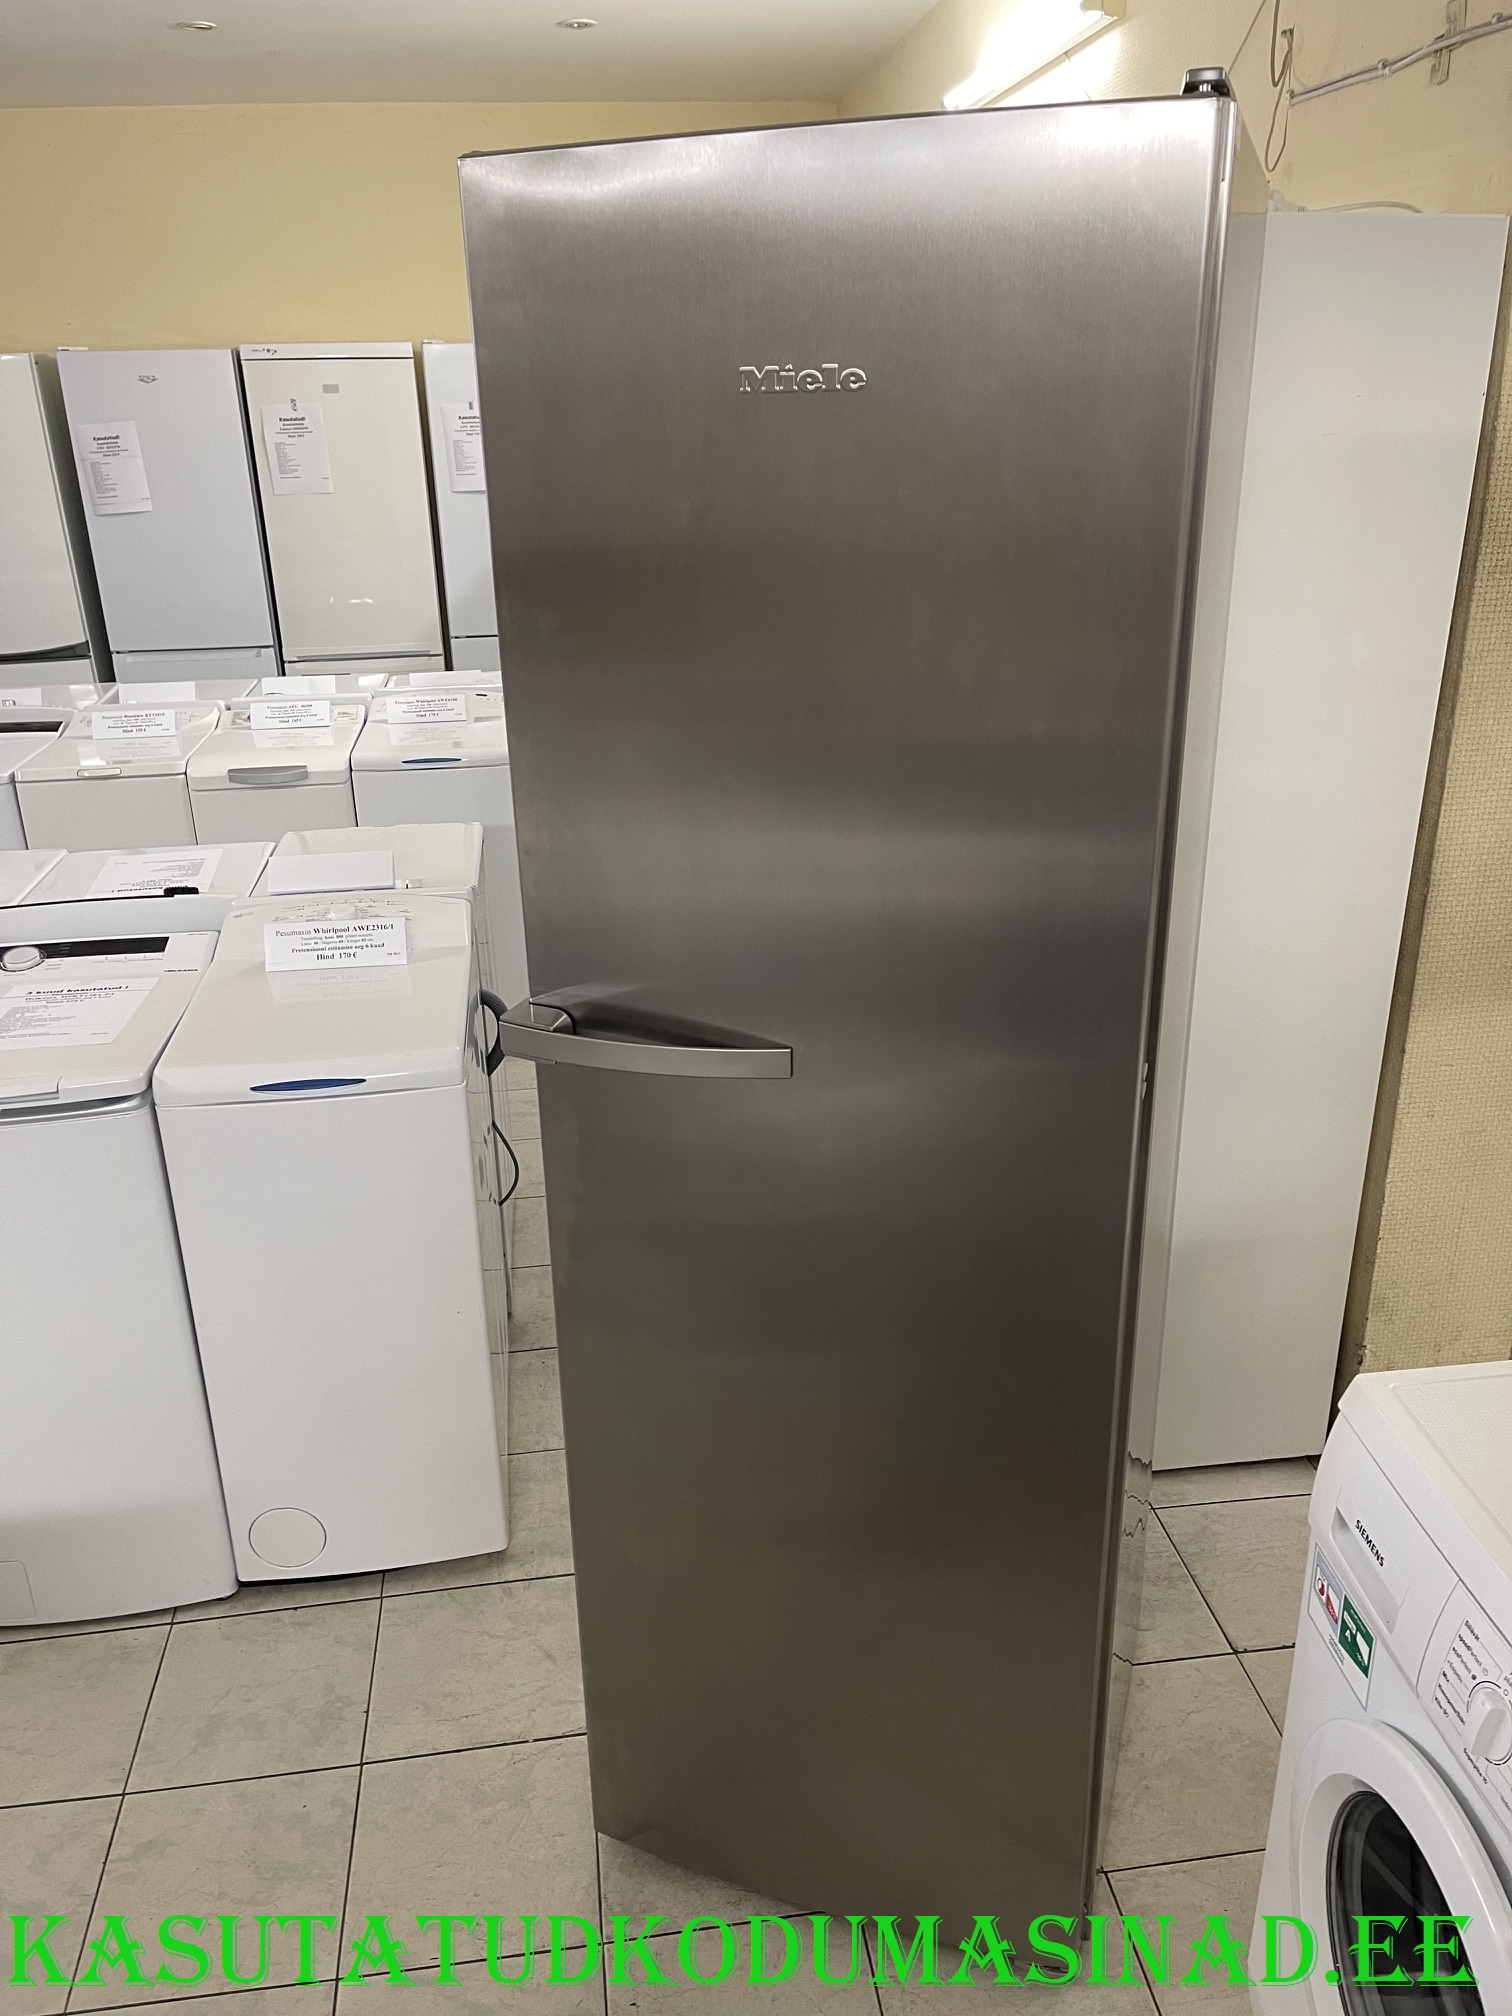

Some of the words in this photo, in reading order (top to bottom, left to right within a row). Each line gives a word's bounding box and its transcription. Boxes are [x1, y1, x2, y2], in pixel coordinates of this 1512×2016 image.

[739, 363, 867, 392] Miele
[275, 929, 312, 937] Pesumasin
[313, 926, 350, 935] Whirlpool
[352, 923, 394, 933] AWE2316/1
[292, 945, 327, 953] Pretensiooni
[1355, 1519, 1386, 1567] SIEMENS
